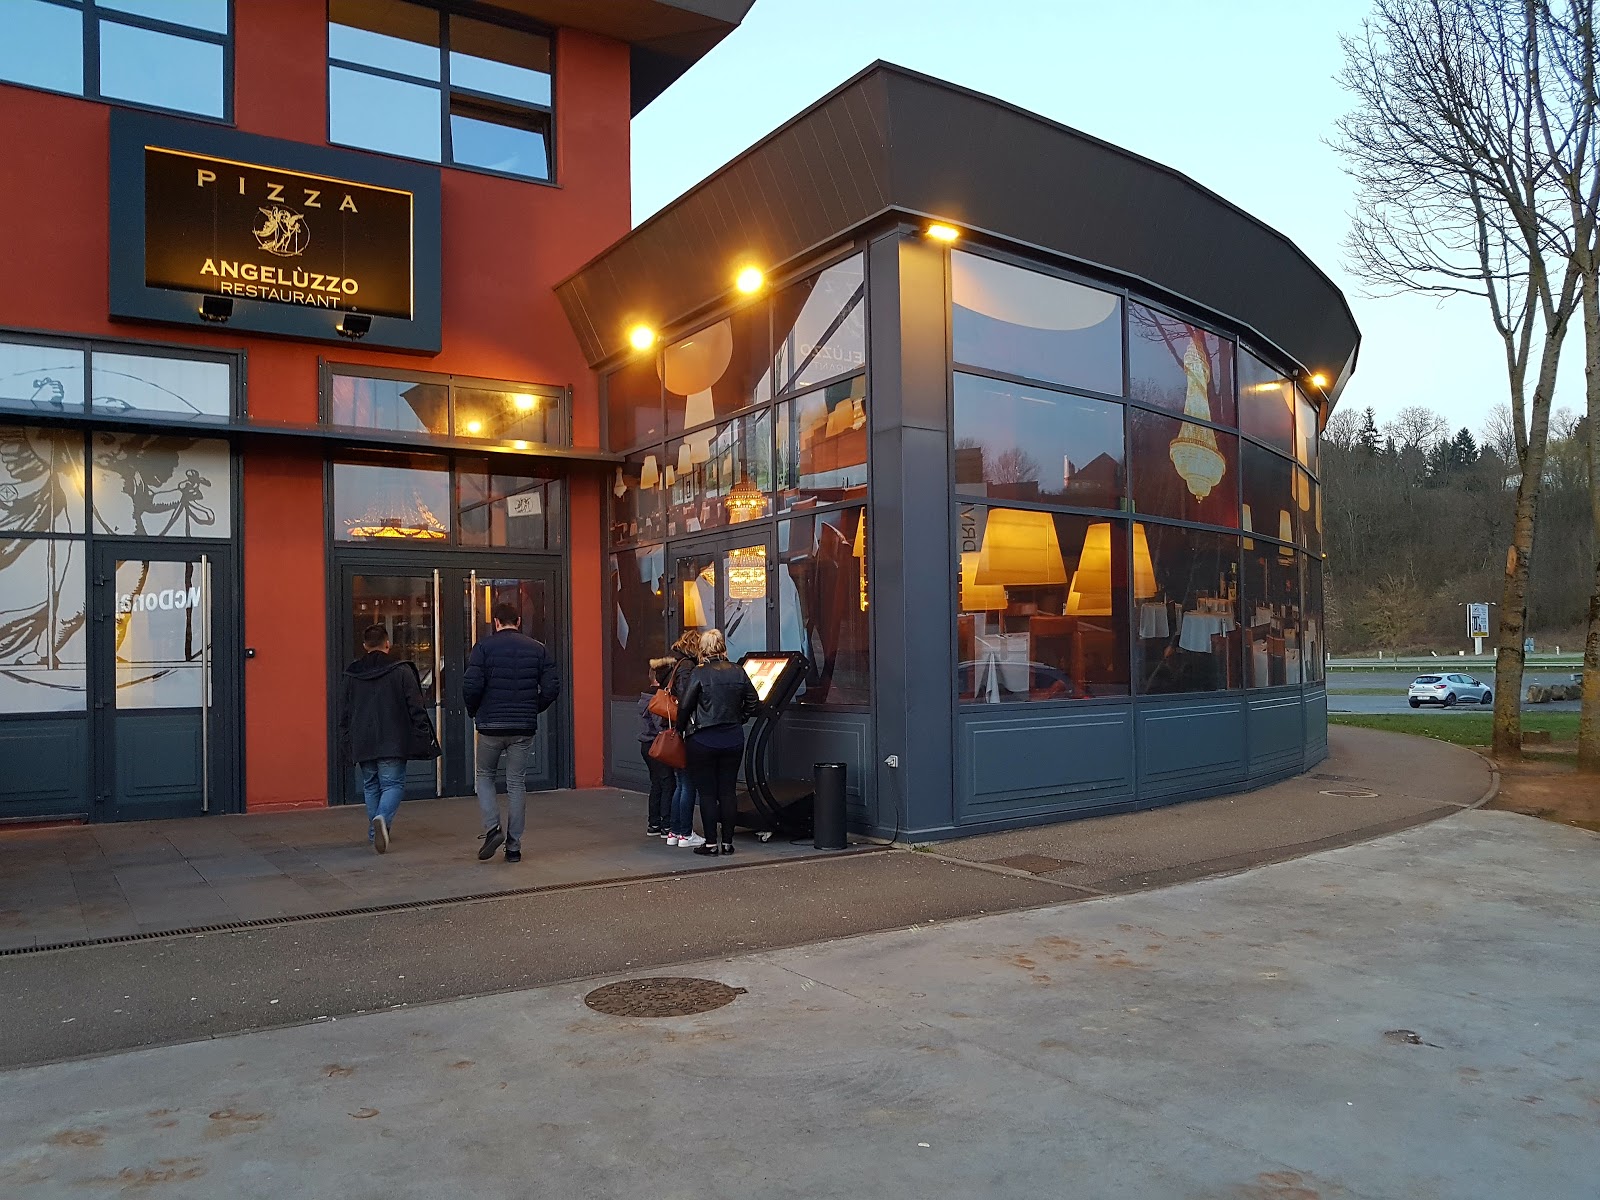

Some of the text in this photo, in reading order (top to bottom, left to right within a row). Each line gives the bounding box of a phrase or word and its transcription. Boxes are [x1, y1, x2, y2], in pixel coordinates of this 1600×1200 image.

[197, 169, 358, 213] PIZZA
[200, 259, 358, 294] ANGELÙZZO
[222, 282, 340, 308] RESTAURANT
